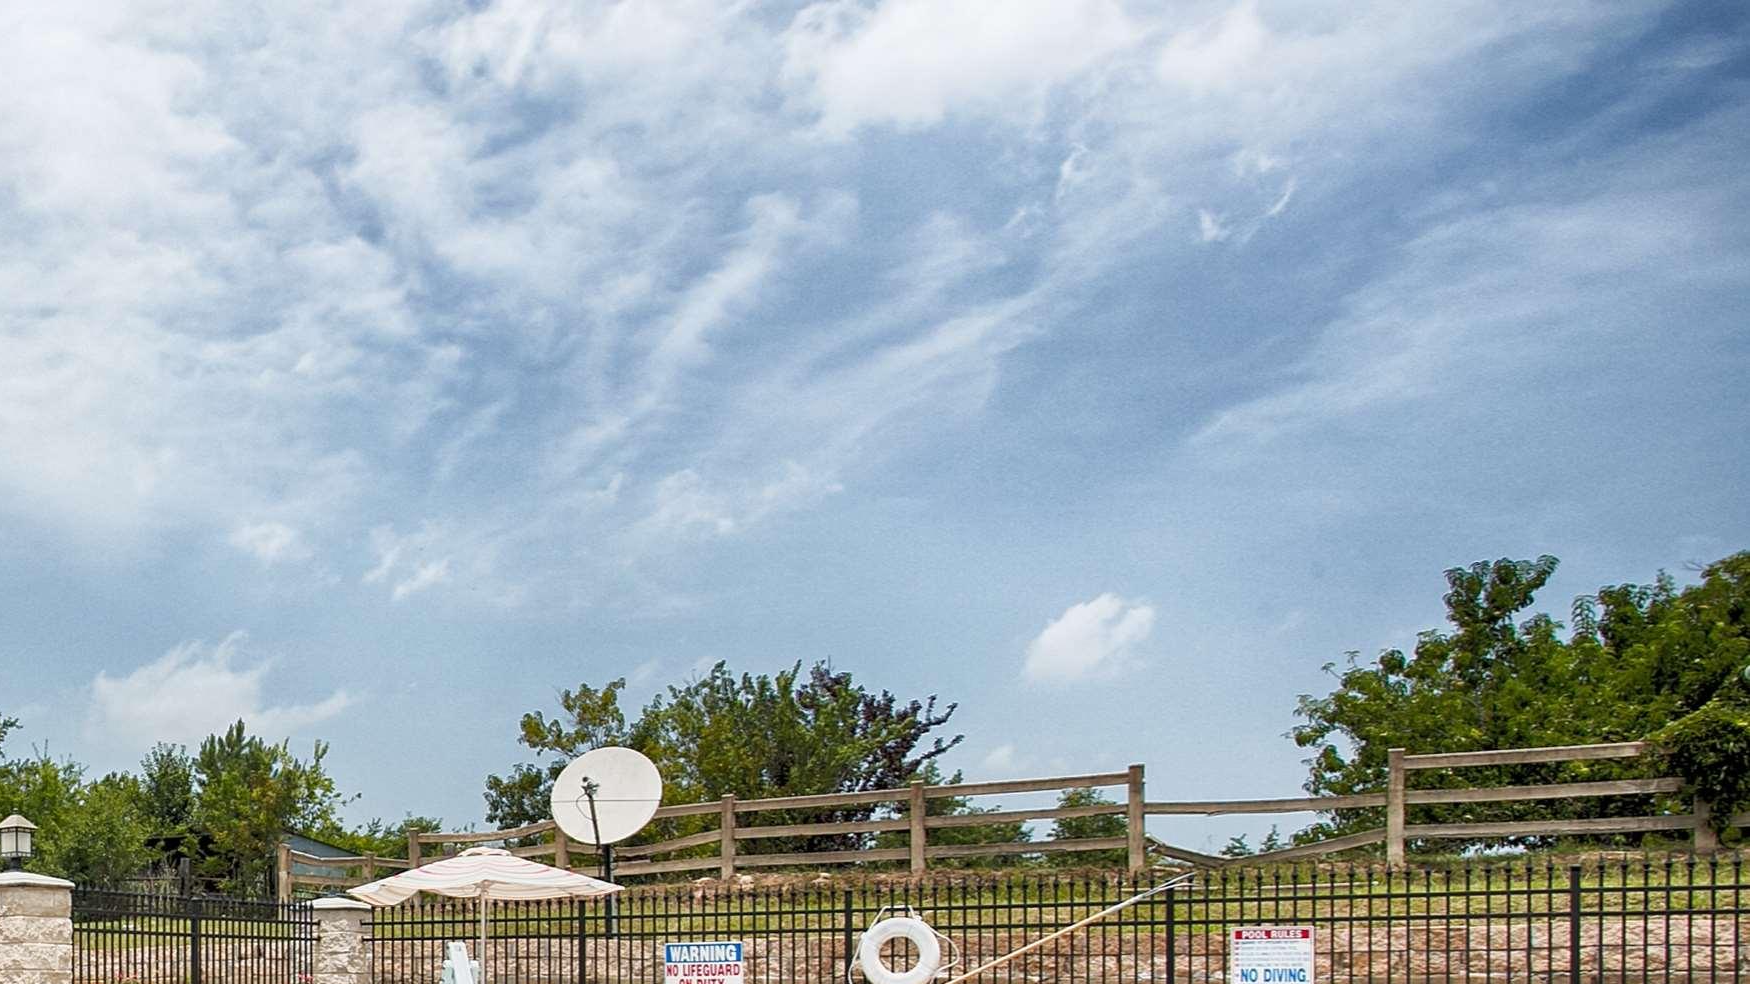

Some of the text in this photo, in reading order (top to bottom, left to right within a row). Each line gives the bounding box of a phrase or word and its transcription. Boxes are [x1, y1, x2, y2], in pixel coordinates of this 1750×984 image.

[1242, 929, 1302, 939] POOL RULES
[670, 944, 737, 962] WARNING
[666, 964, 740, 977] NO LIFEGUARD
[1240, 967, 1307, 983] NO DIVING
